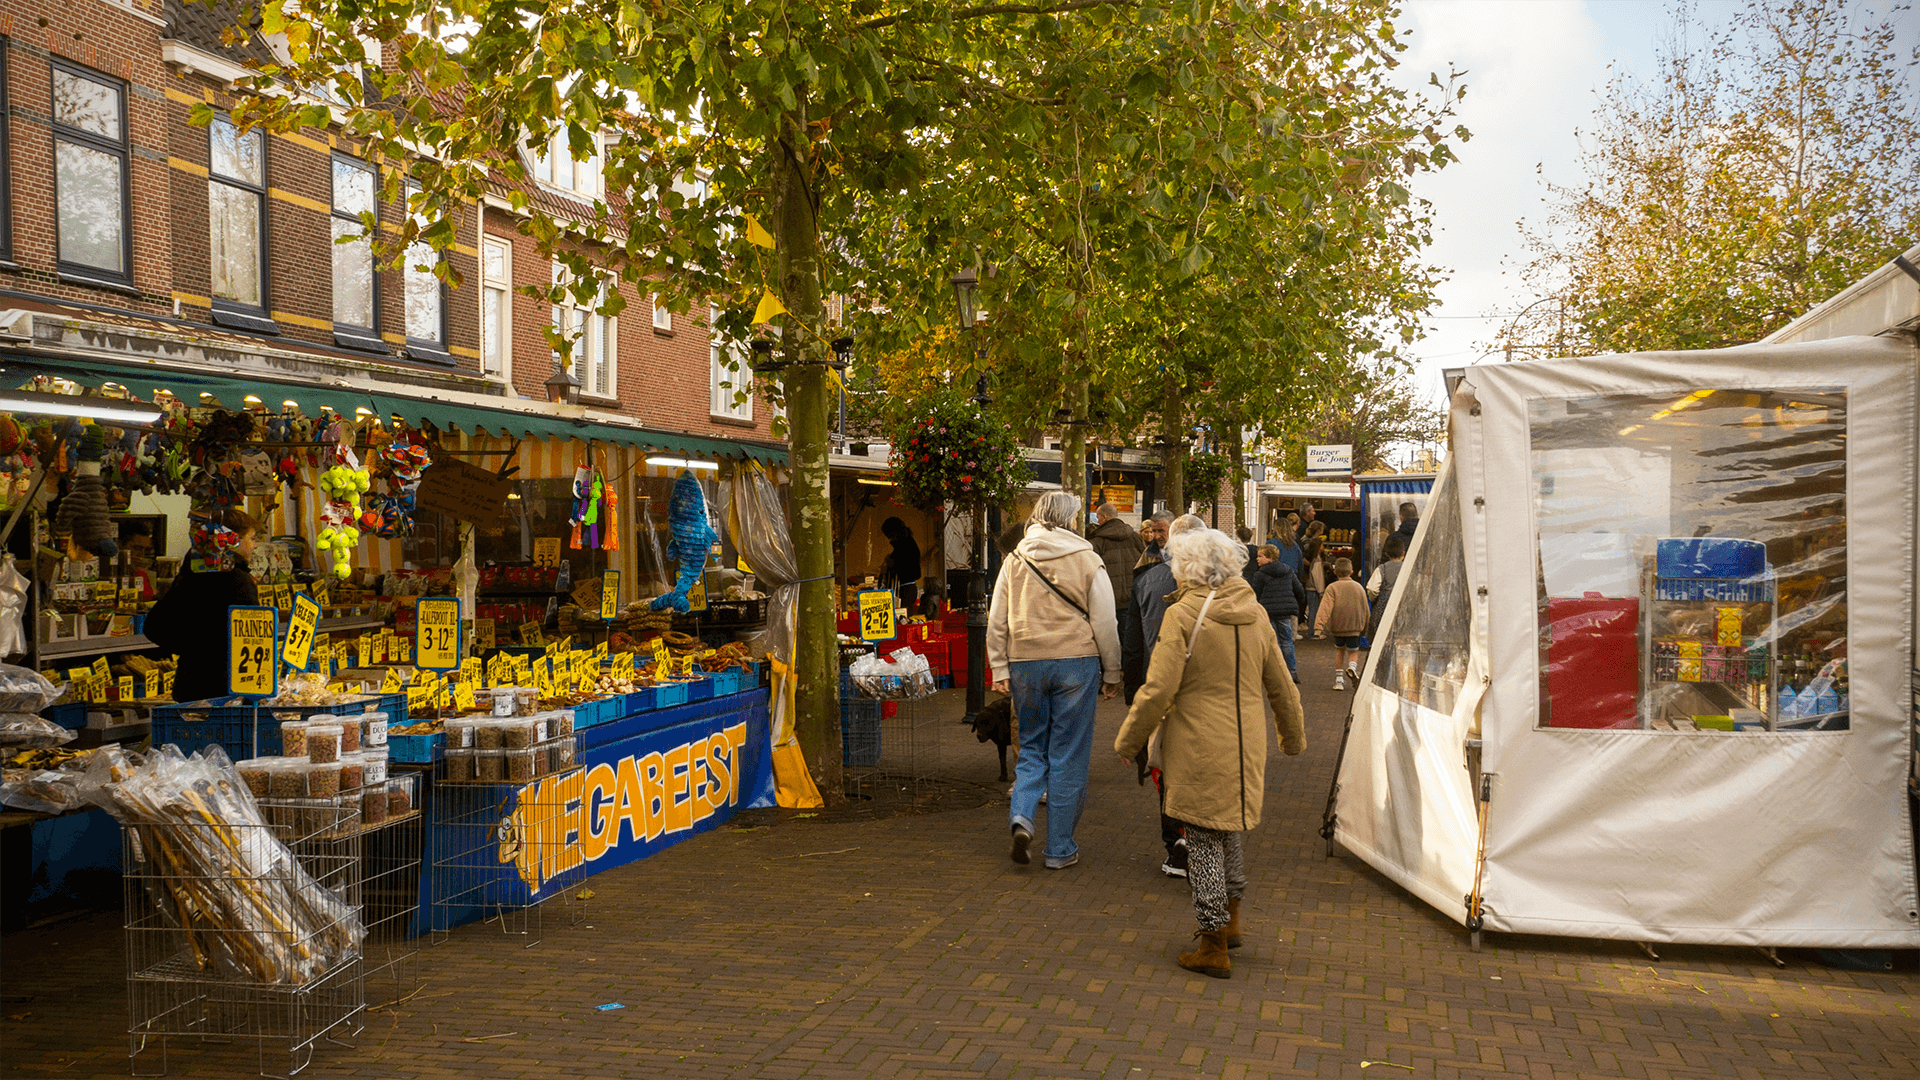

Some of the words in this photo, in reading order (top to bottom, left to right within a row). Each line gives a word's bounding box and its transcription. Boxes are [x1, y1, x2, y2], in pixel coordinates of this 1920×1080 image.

[1310, 449, 1341, 457] Burger
[1328, 456, 1349, 464] Jong
[233, 619, 274, 638] TRAINERS
[878, 611, 889, 629] 12
[518, 721, 746, 896] MEGABEEST
